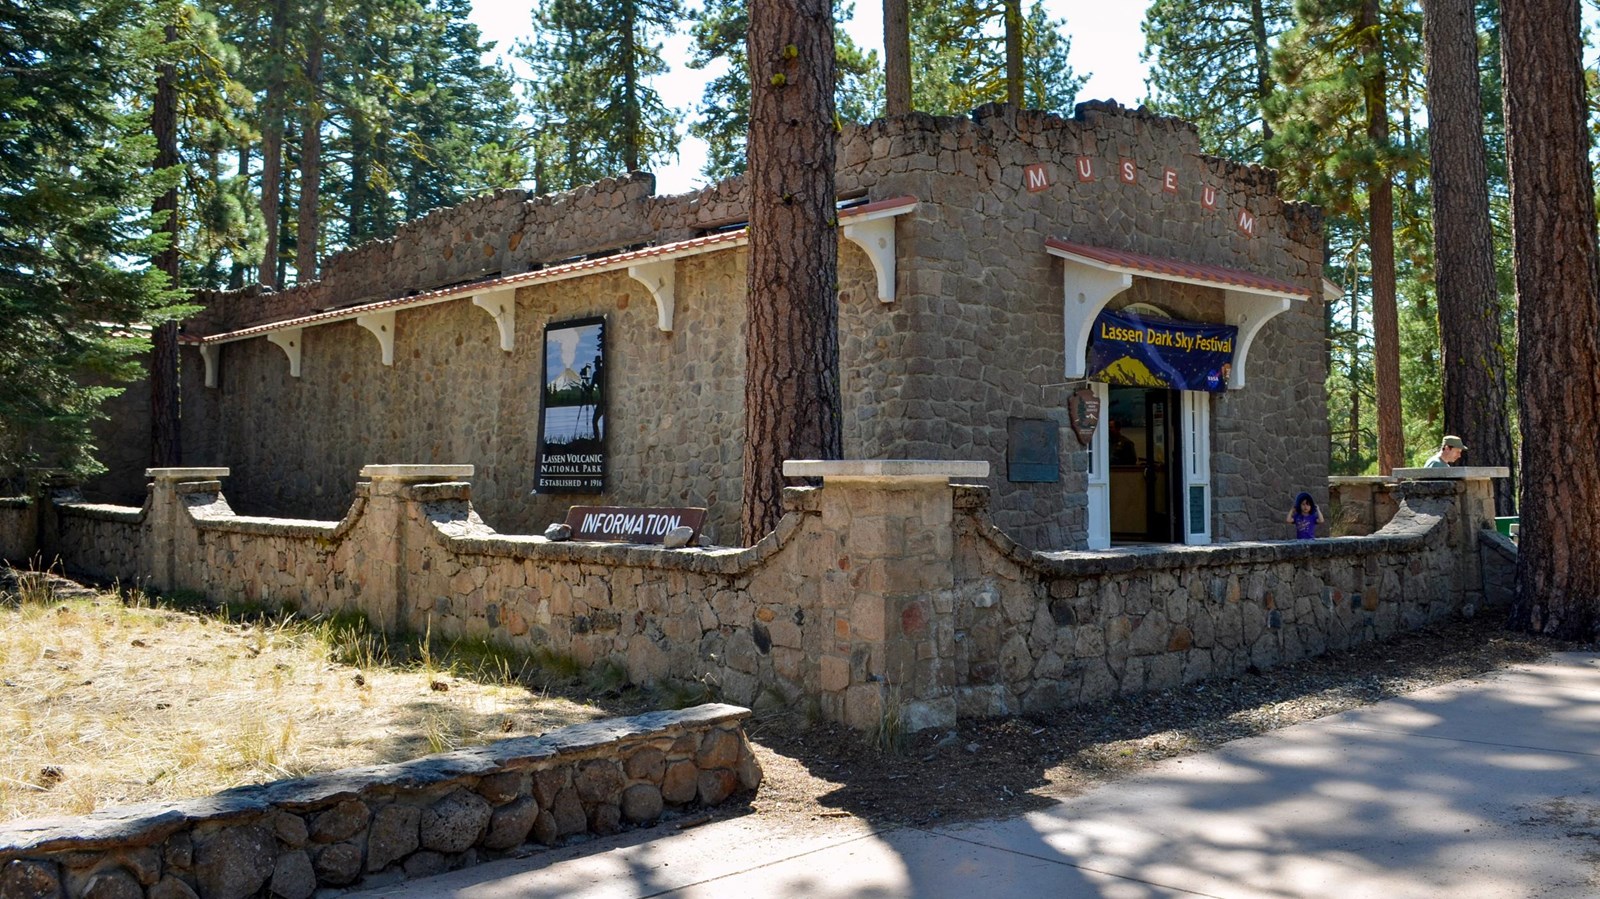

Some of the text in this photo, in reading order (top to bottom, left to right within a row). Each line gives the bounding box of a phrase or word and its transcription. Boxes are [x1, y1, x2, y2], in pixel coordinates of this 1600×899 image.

[1029, 160, 1253, 233] MUSEUM
[1101, 322, 1232, 353] Lassen Dark Sky Festival
[541, 453, 603, 463] LASSEN VOLCANIC
[540, 464, 602, 473] NATIONAL PARK
[539, 478, 603, 487] ESTABLISHED 1916
[580, 513, 681, 536] INFORMATION
